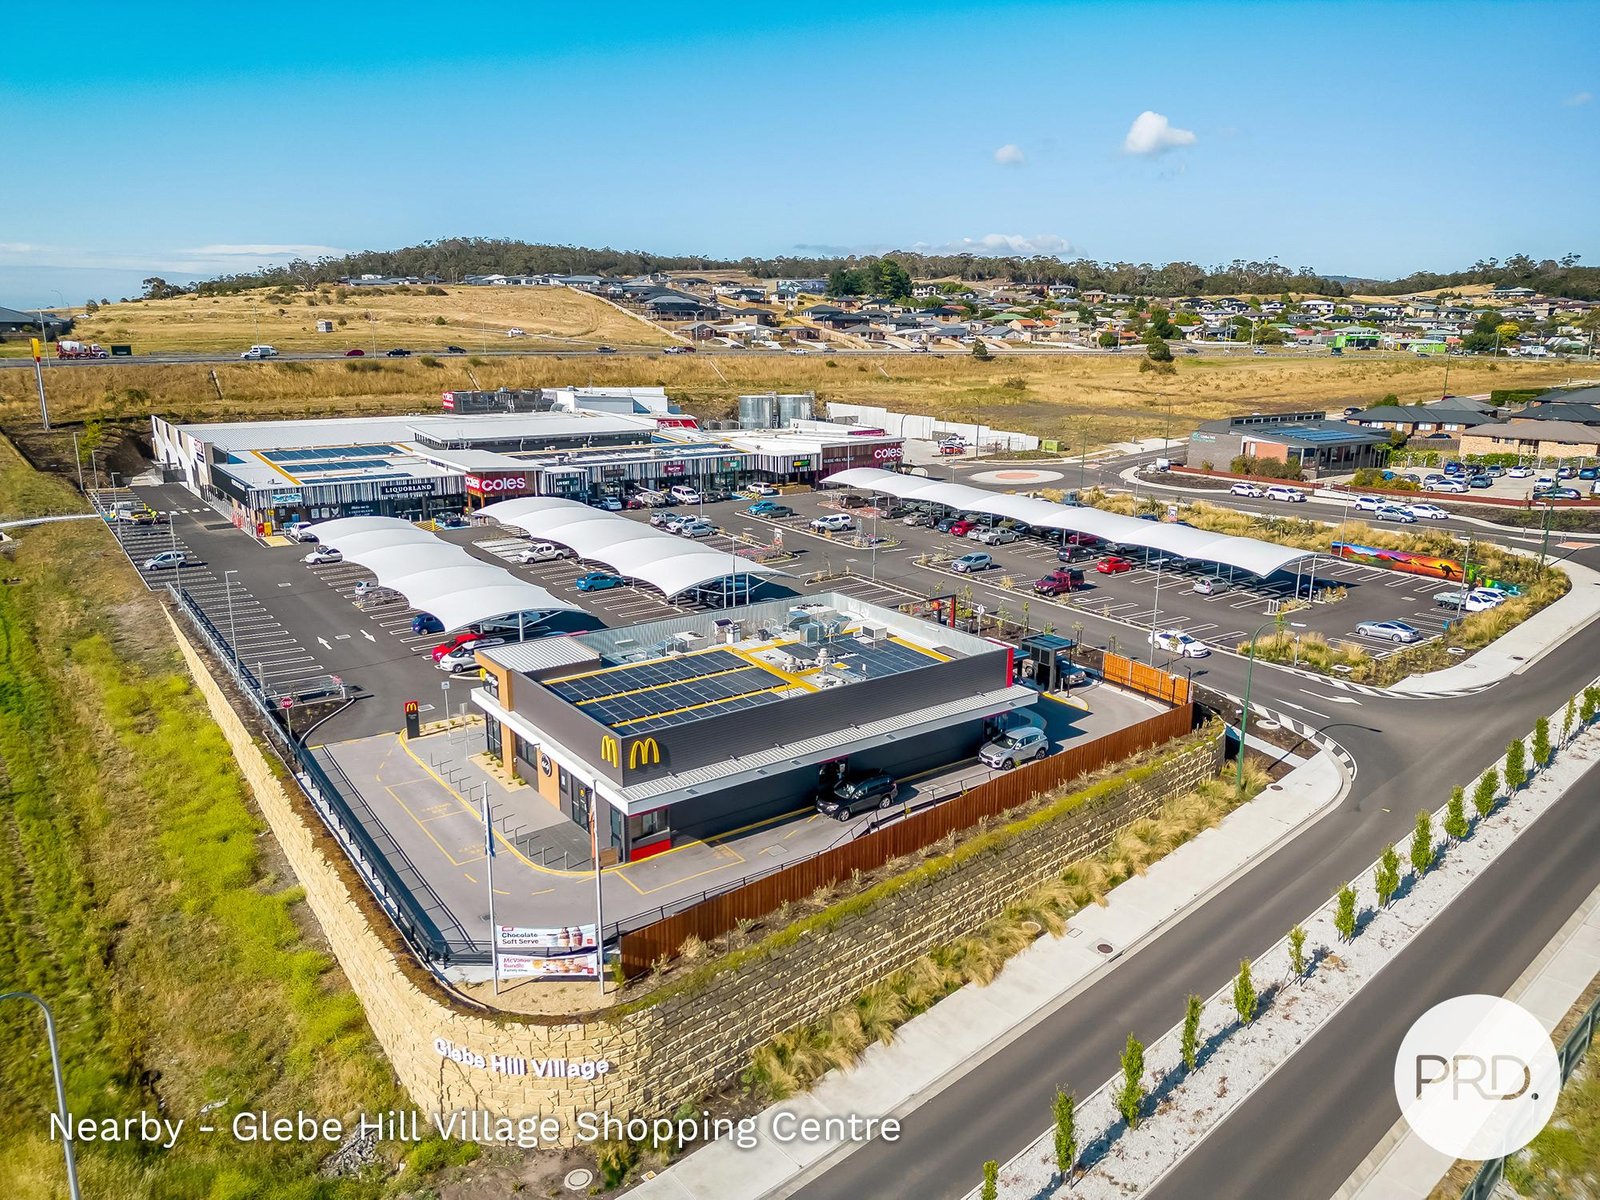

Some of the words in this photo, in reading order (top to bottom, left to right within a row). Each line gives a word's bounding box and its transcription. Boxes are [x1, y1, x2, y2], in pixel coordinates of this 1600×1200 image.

[874, 447, 903, 459] coles
[385, 484, 432, 494] LIQUORLAND
[465, 476, 480, 489] coles
[481, 477, 526, 491] coles
[434, 1037, 486, 1069] Glebe
[491, 1055, 526, 1075] Hill
[531, 1058, 610, 1080] Village
